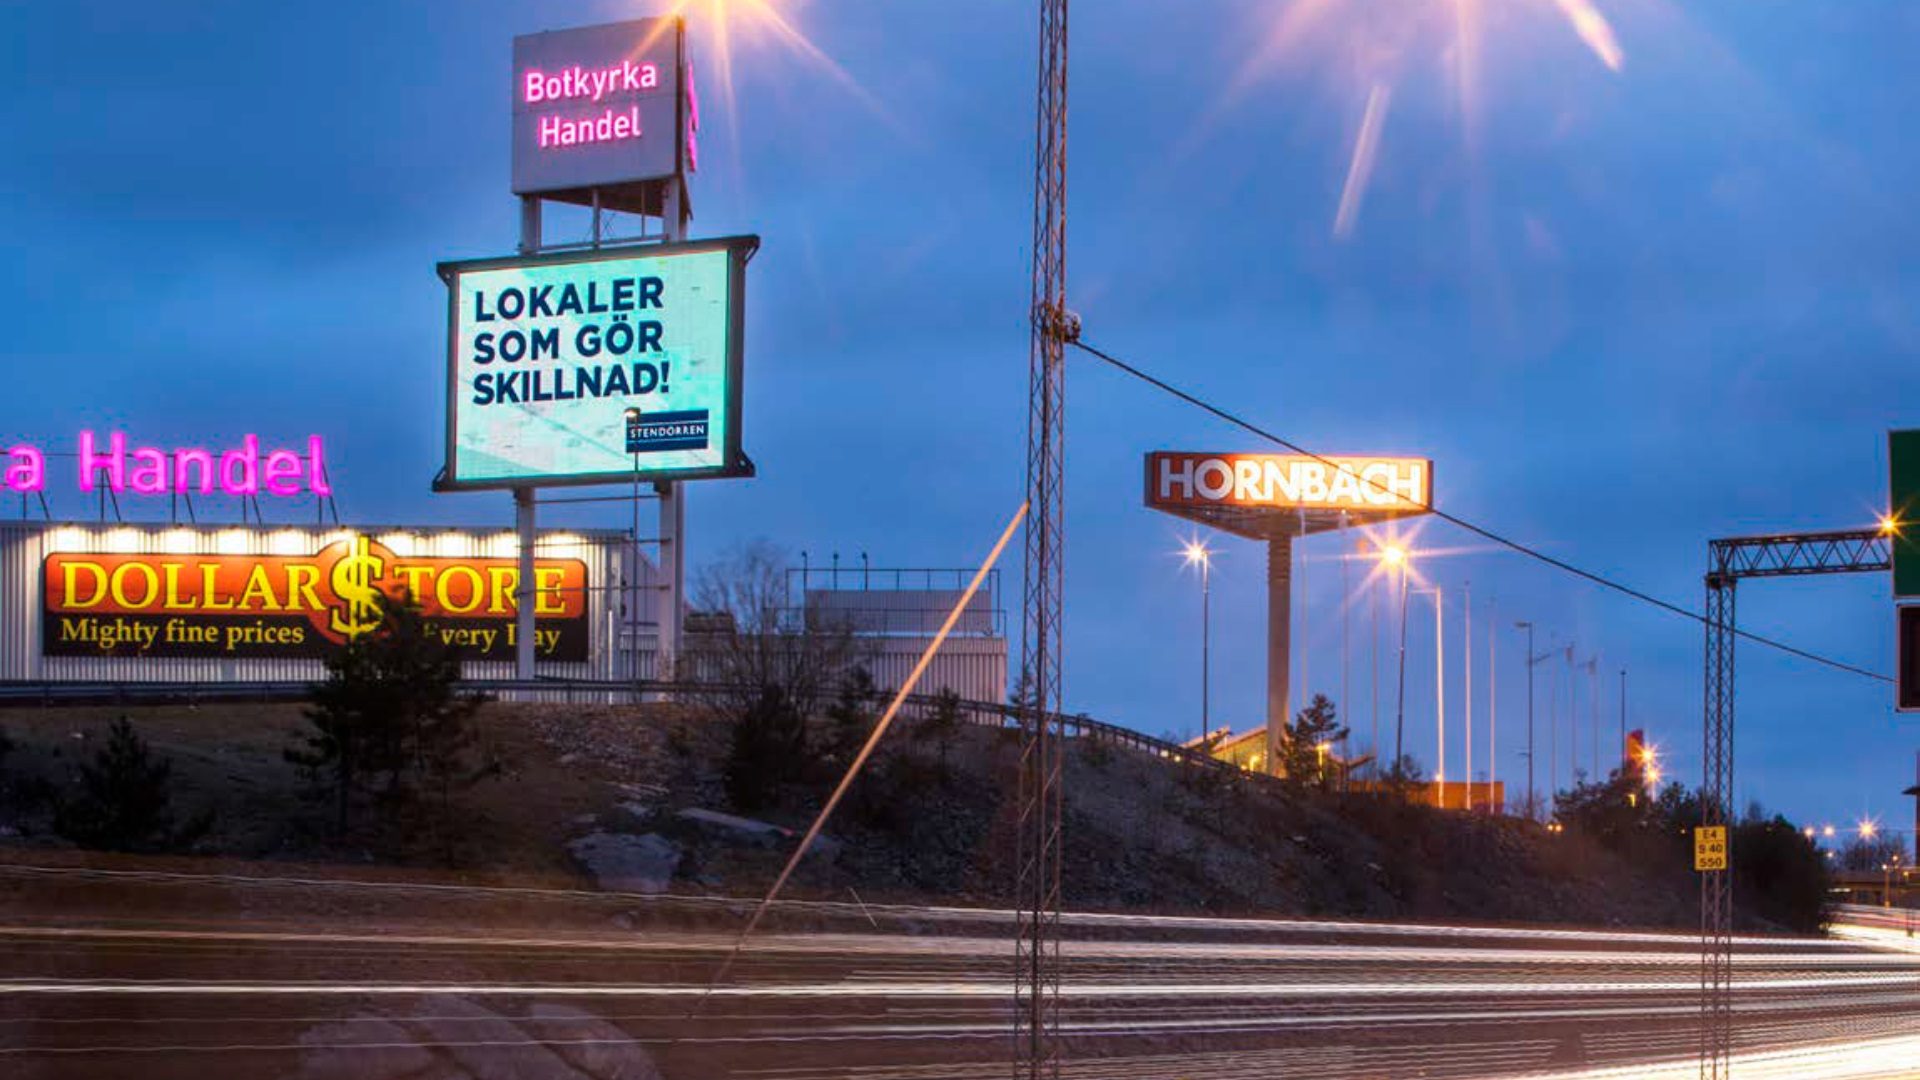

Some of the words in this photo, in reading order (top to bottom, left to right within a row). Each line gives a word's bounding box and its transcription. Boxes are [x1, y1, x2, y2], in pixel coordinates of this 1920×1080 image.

[524, 61, 657, 102] Botkyrka
[539, 106, 642, 147] Handel
[475, 276, 664, 322] LOKALER
[473, 327, 559, 365] SOM
[575, 316, 663, 358] GÖR
[473, 361, 670, 405] SKILLNAD!
[79, 429, 332, 496] Handel
[1159, 458, 1422, 505] HORNBACH
[61, 618, 159, 650] Mighty
[166, 618, 220, 643] fine
[225, 620, 305, 651] prices
[1703, 829, 1717, 840] E4
